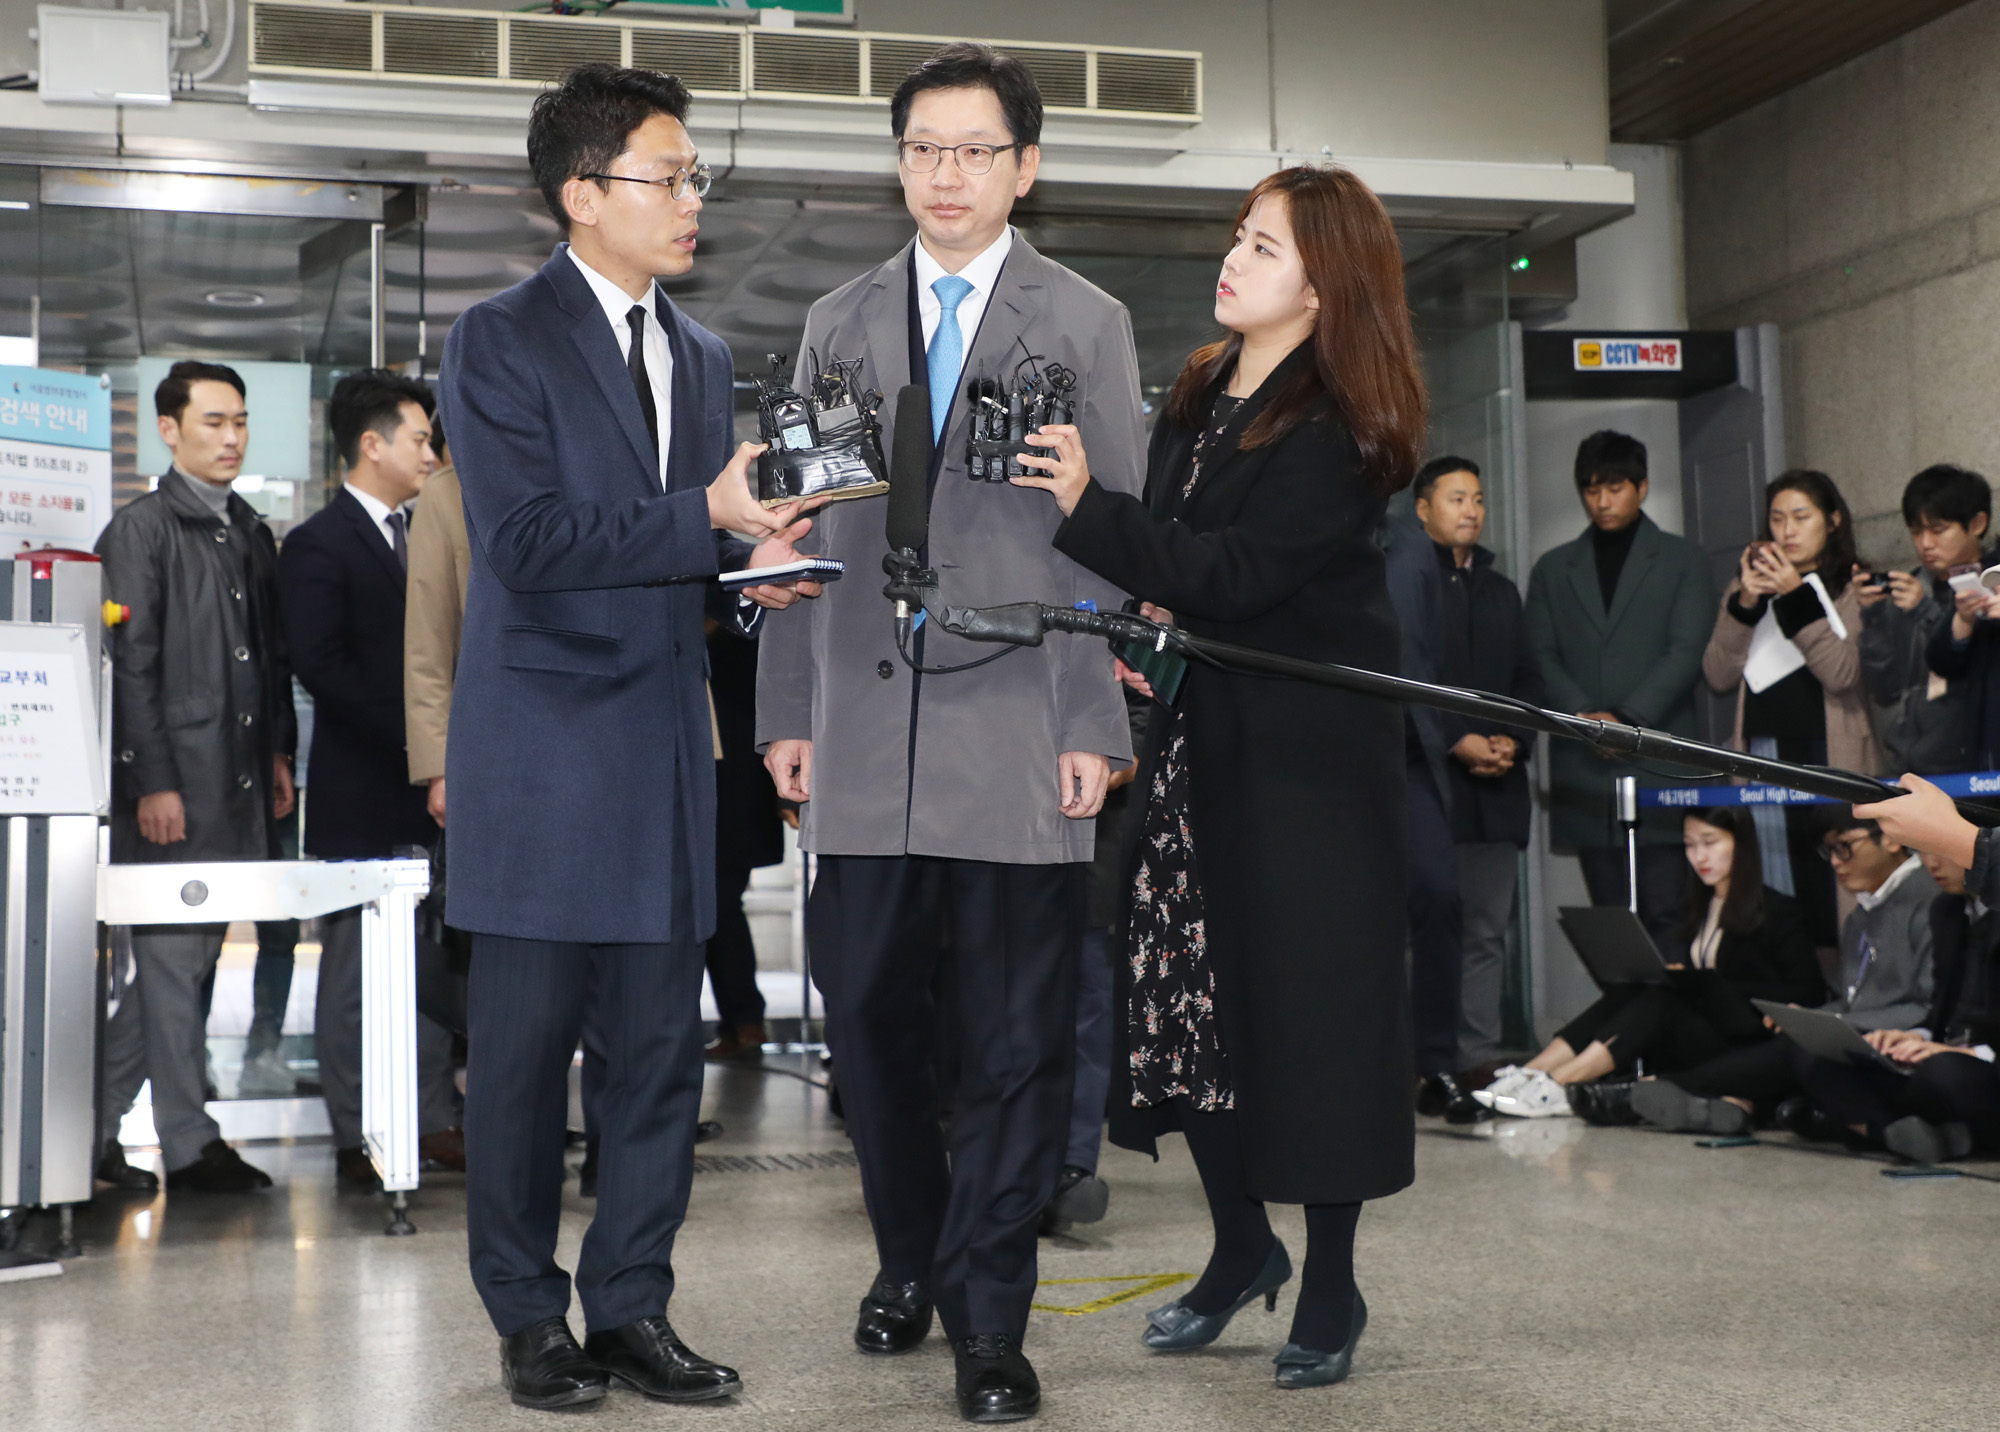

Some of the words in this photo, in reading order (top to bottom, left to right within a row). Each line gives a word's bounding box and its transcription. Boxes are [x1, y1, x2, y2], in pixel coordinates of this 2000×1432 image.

[0, 397, 40, 427] 검색
[45, 403, 88, 433] 안내
[1740, 787, 1764, 803] Seoul
[1766, 786, 1788, 804] High
